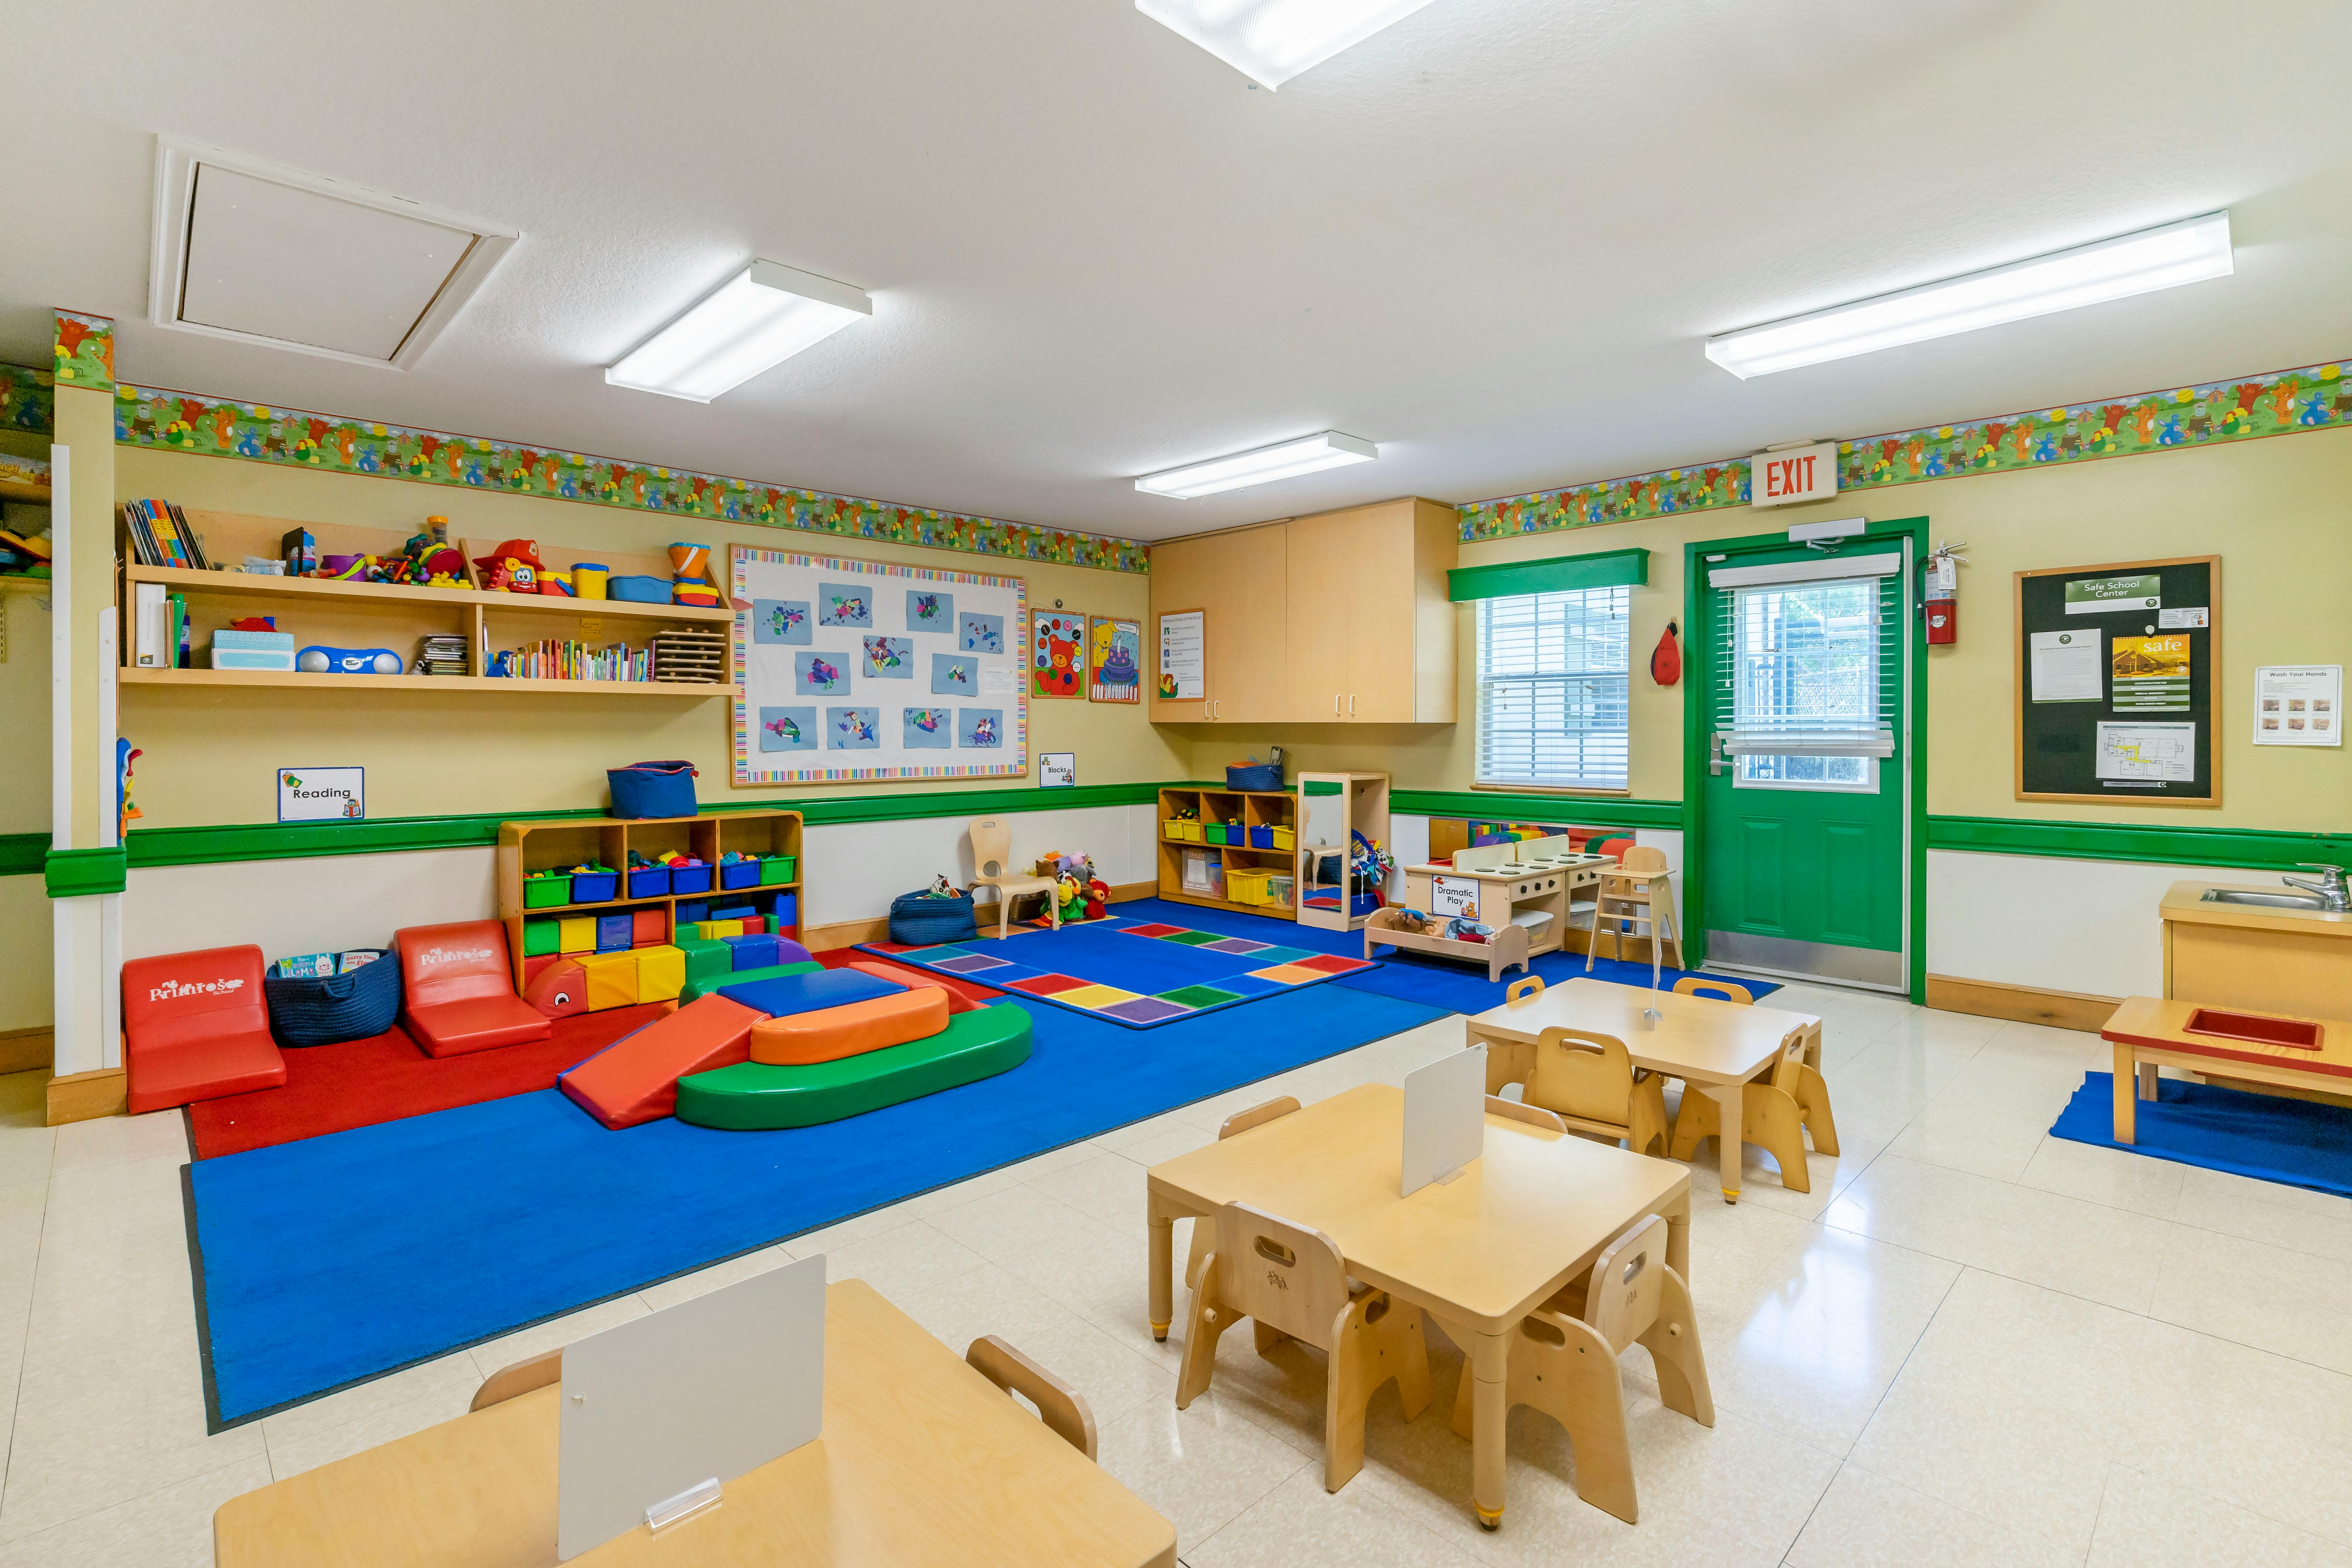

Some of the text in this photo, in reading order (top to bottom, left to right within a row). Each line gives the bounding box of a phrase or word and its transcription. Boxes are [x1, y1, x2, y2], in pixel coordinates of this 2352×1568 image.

[1767, 456, 1816, 497] EXIT
[167, 539, 177, 558] animals
[2084, 580, 2140, 591] Safe School
[2144, 638, 2181, 652] safe
[1105, 668, 1133, 679] PRIMROSE
[293, 788, 350, 799] Reading
[1438, 886, 1474, 897] Dramatic
[1447, 896, 1464, 907] Play
[421, 948, 492, 965] Primrose
[150, 979, 244, 1002] Primrose
